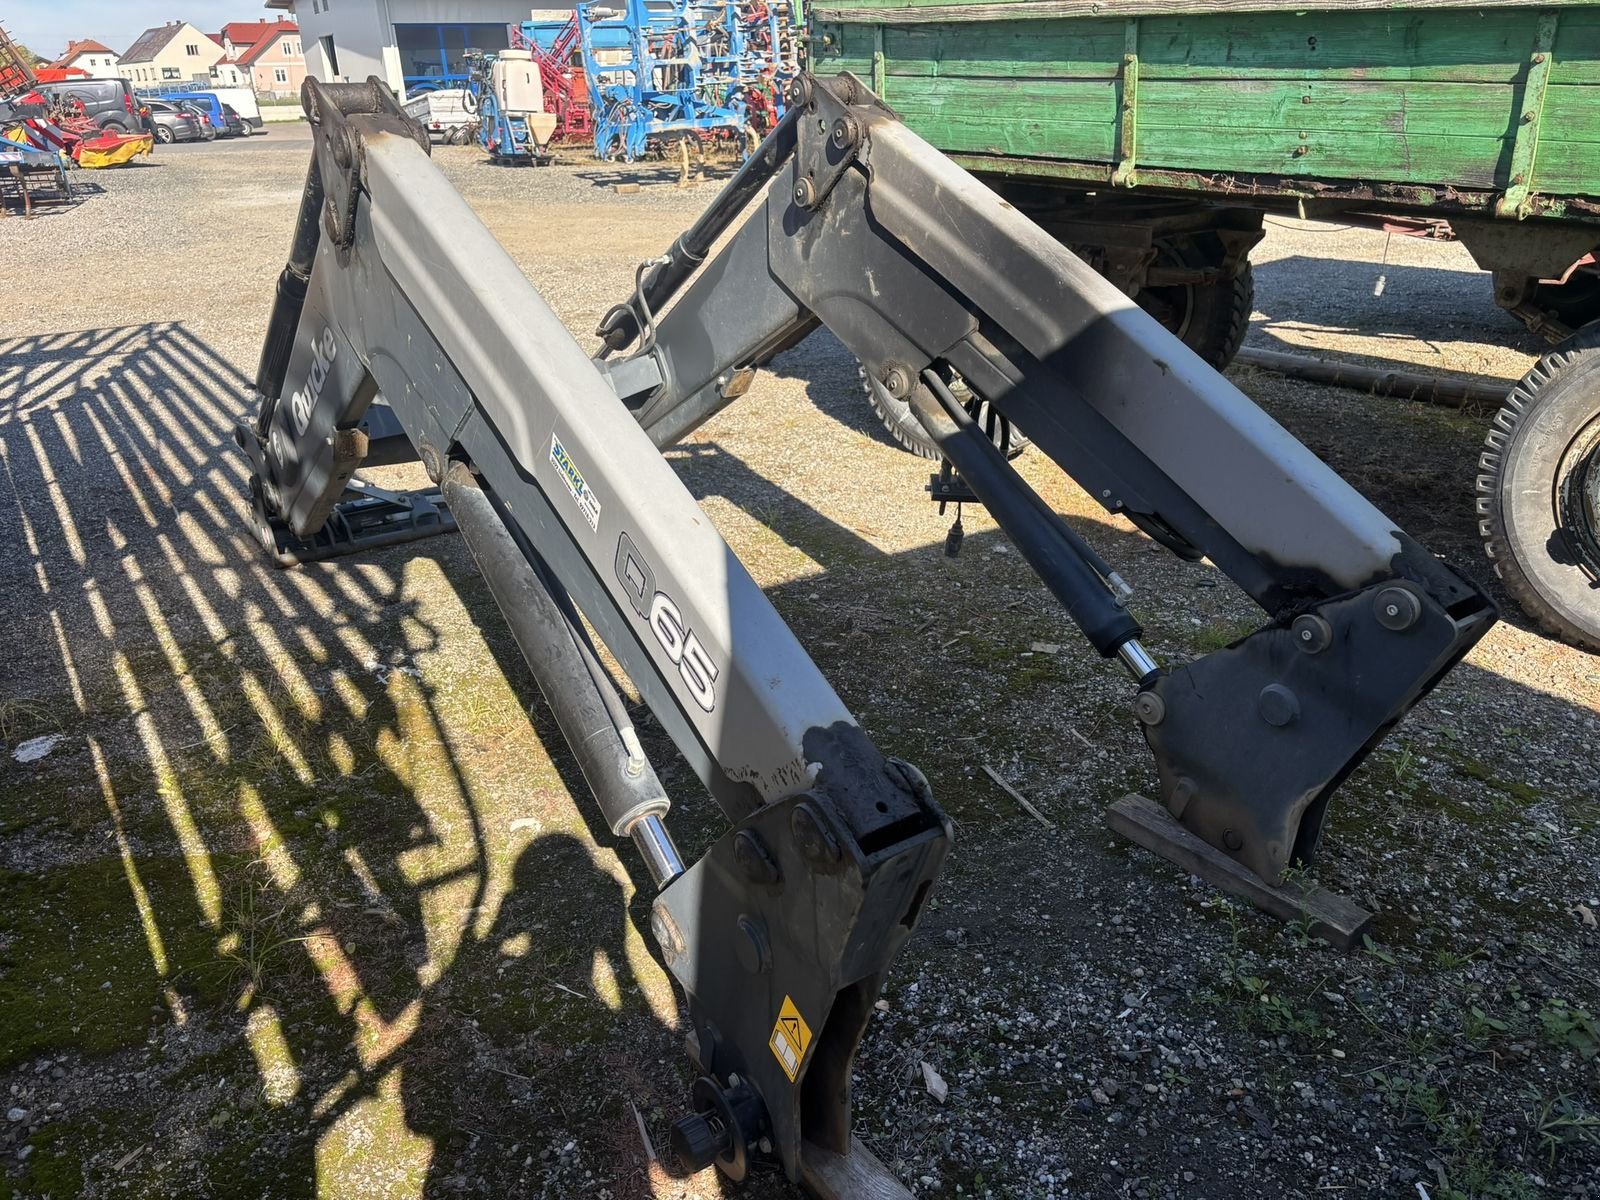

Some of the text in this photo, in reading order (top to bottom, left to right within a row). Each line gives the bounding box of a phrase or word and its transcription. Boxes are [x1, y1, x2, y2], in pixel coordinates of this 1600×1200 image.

[291, 326, 337, 437] Quicke
[553, 442, 583, 495] STARKL
[614, 530, 719, 713] Q65
